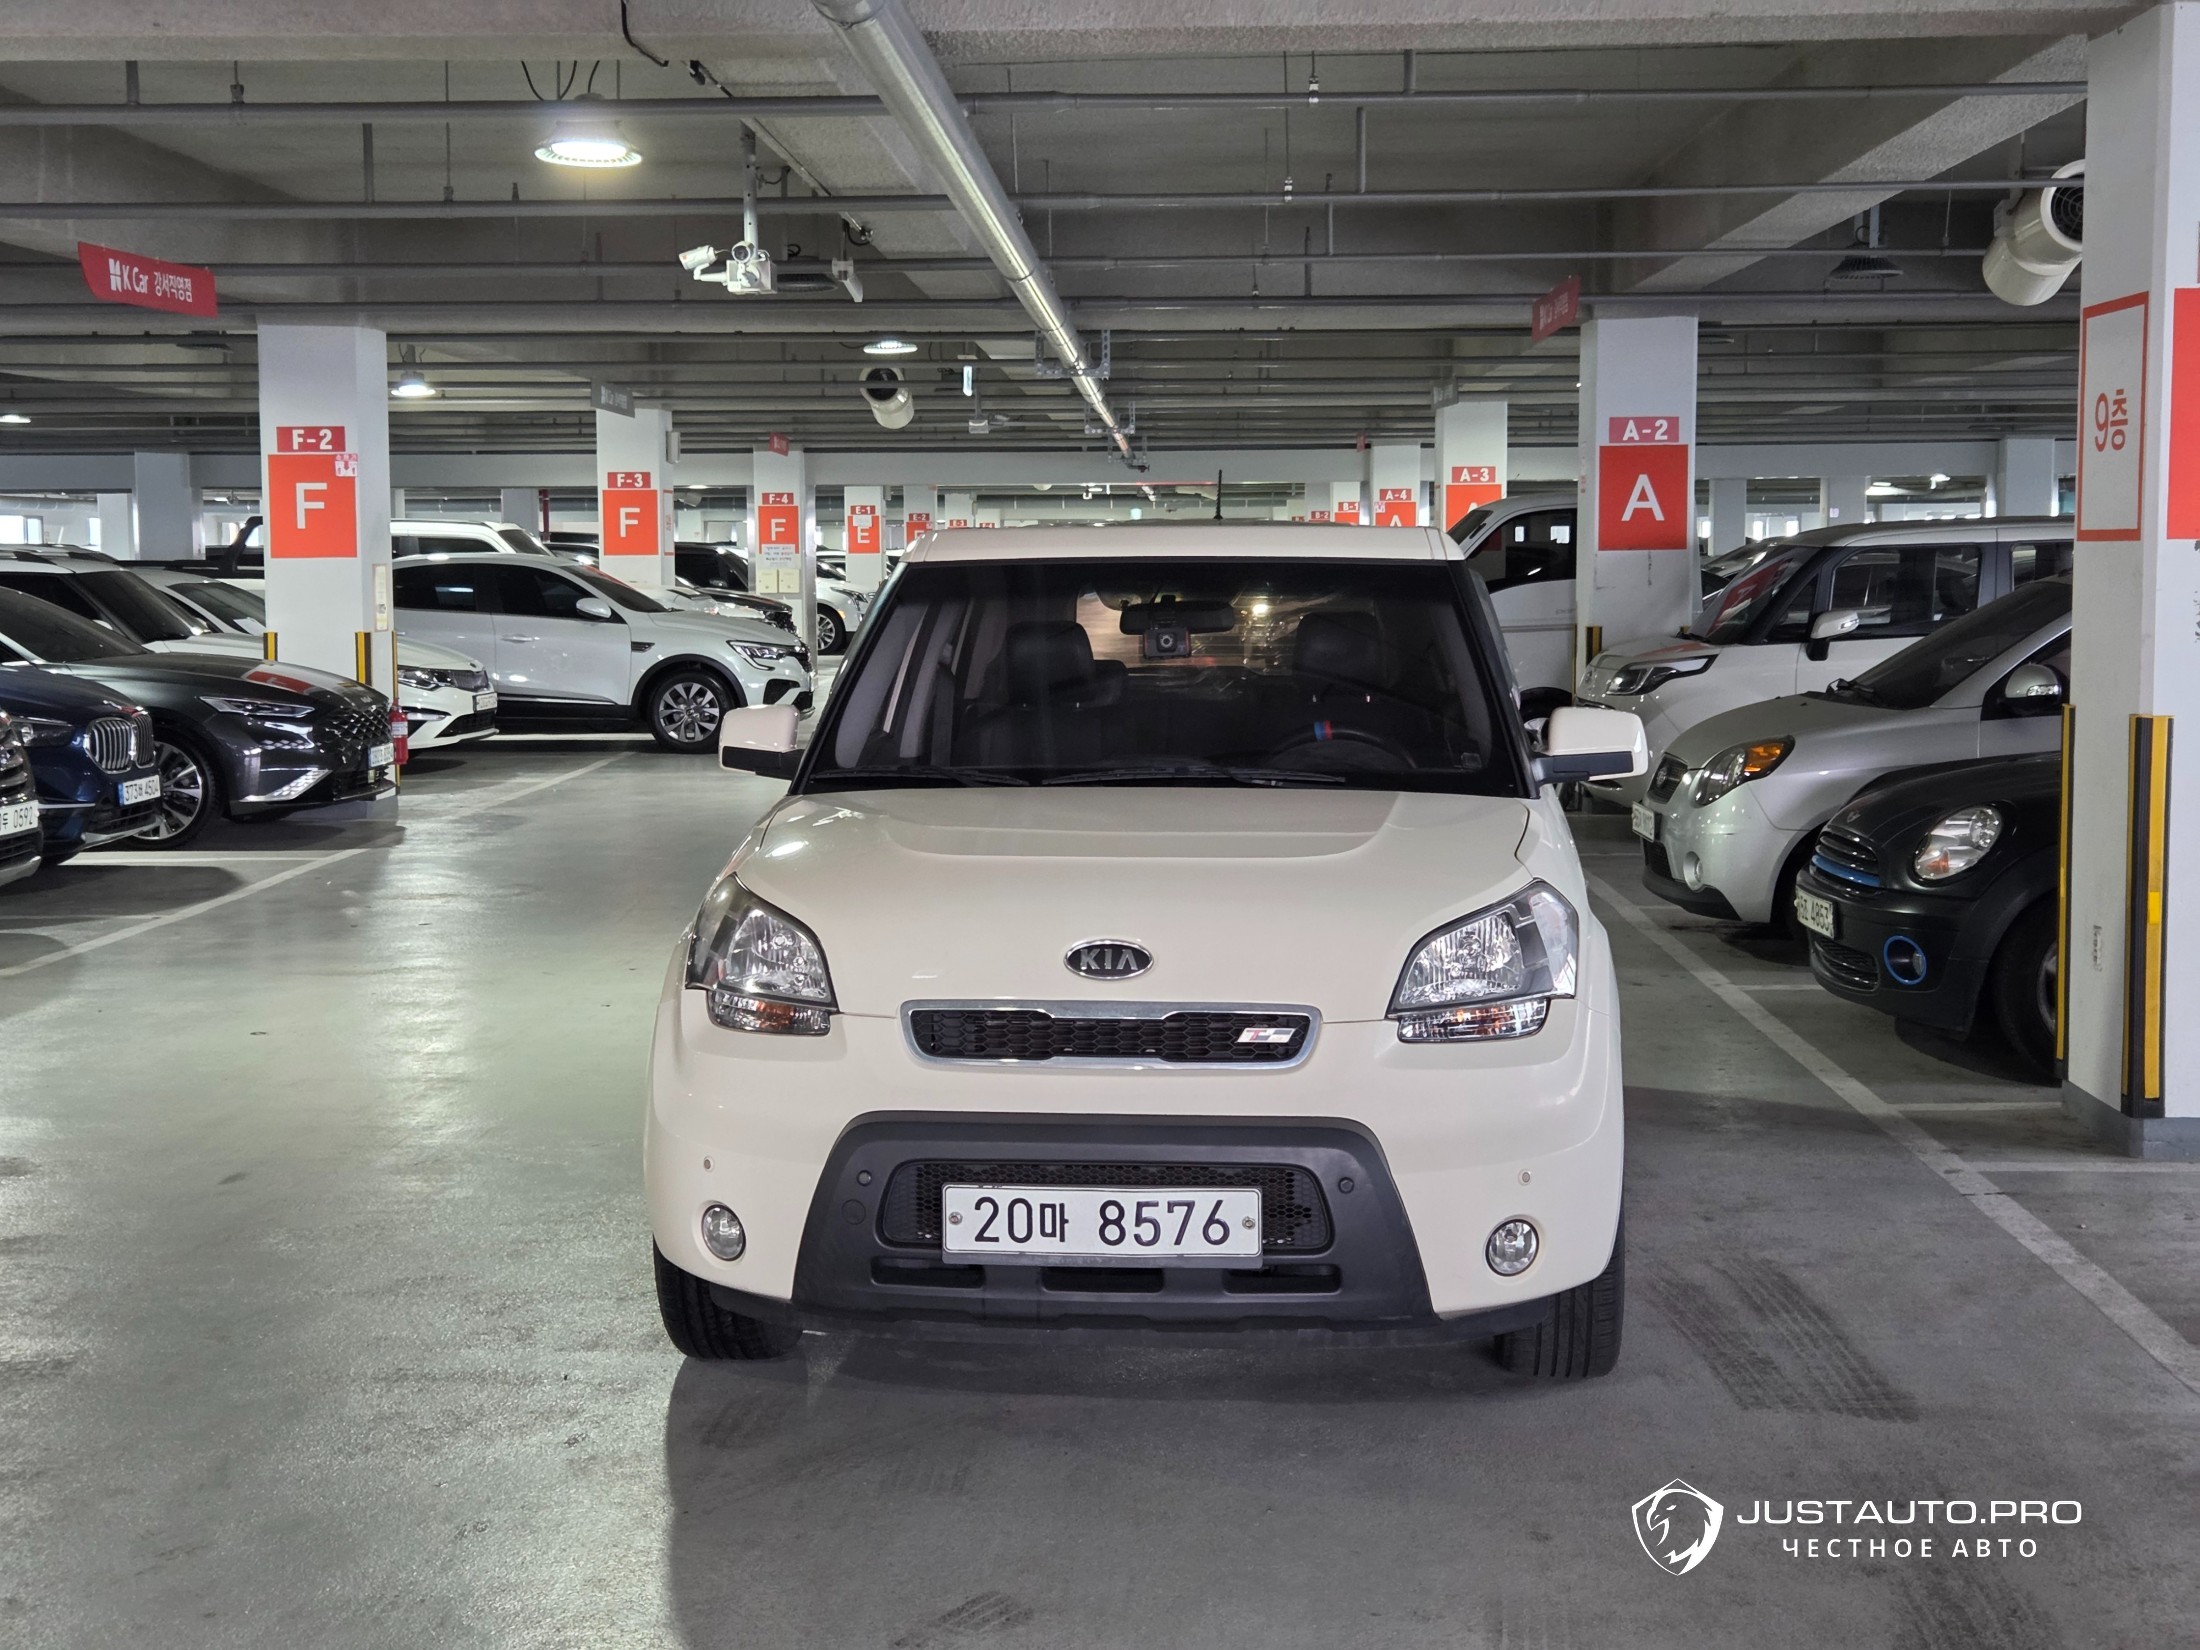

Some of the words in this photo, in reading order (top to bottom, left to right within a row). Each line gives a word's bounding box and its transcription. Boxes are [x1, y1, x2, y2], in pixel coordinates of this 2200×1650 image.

[122, 264, 132, 291] K
[132, 266, 149, 294] Car
[1622, 419, 1668, 441] A-2
[2094, 388, 2129, 453] 9층
[292, 428, 333, 451] F-2
[616, 473, 643, 488] F-3
[1459, 467, 1490, 482] A-3
[295, 482, 328, 530] F
[768, 493, 789, 505] F-4
[1385, 489, 1408, 501] A-4
[1621, 473, 1665, 522] A
[855, 506, 871, 515] E-1
[912, 513, 927, 522] E-2
[619, 507, 641, 538] F
[770, 518, 787, 542] F
[857, 526, 871, 544] E
[13, 806, 33, 829] 0592
[1079, 948, 1139, 971] KIA
[973, 1196, 1069, 1244] 20마
[1098, 1199, 1231, 1247] 8576
